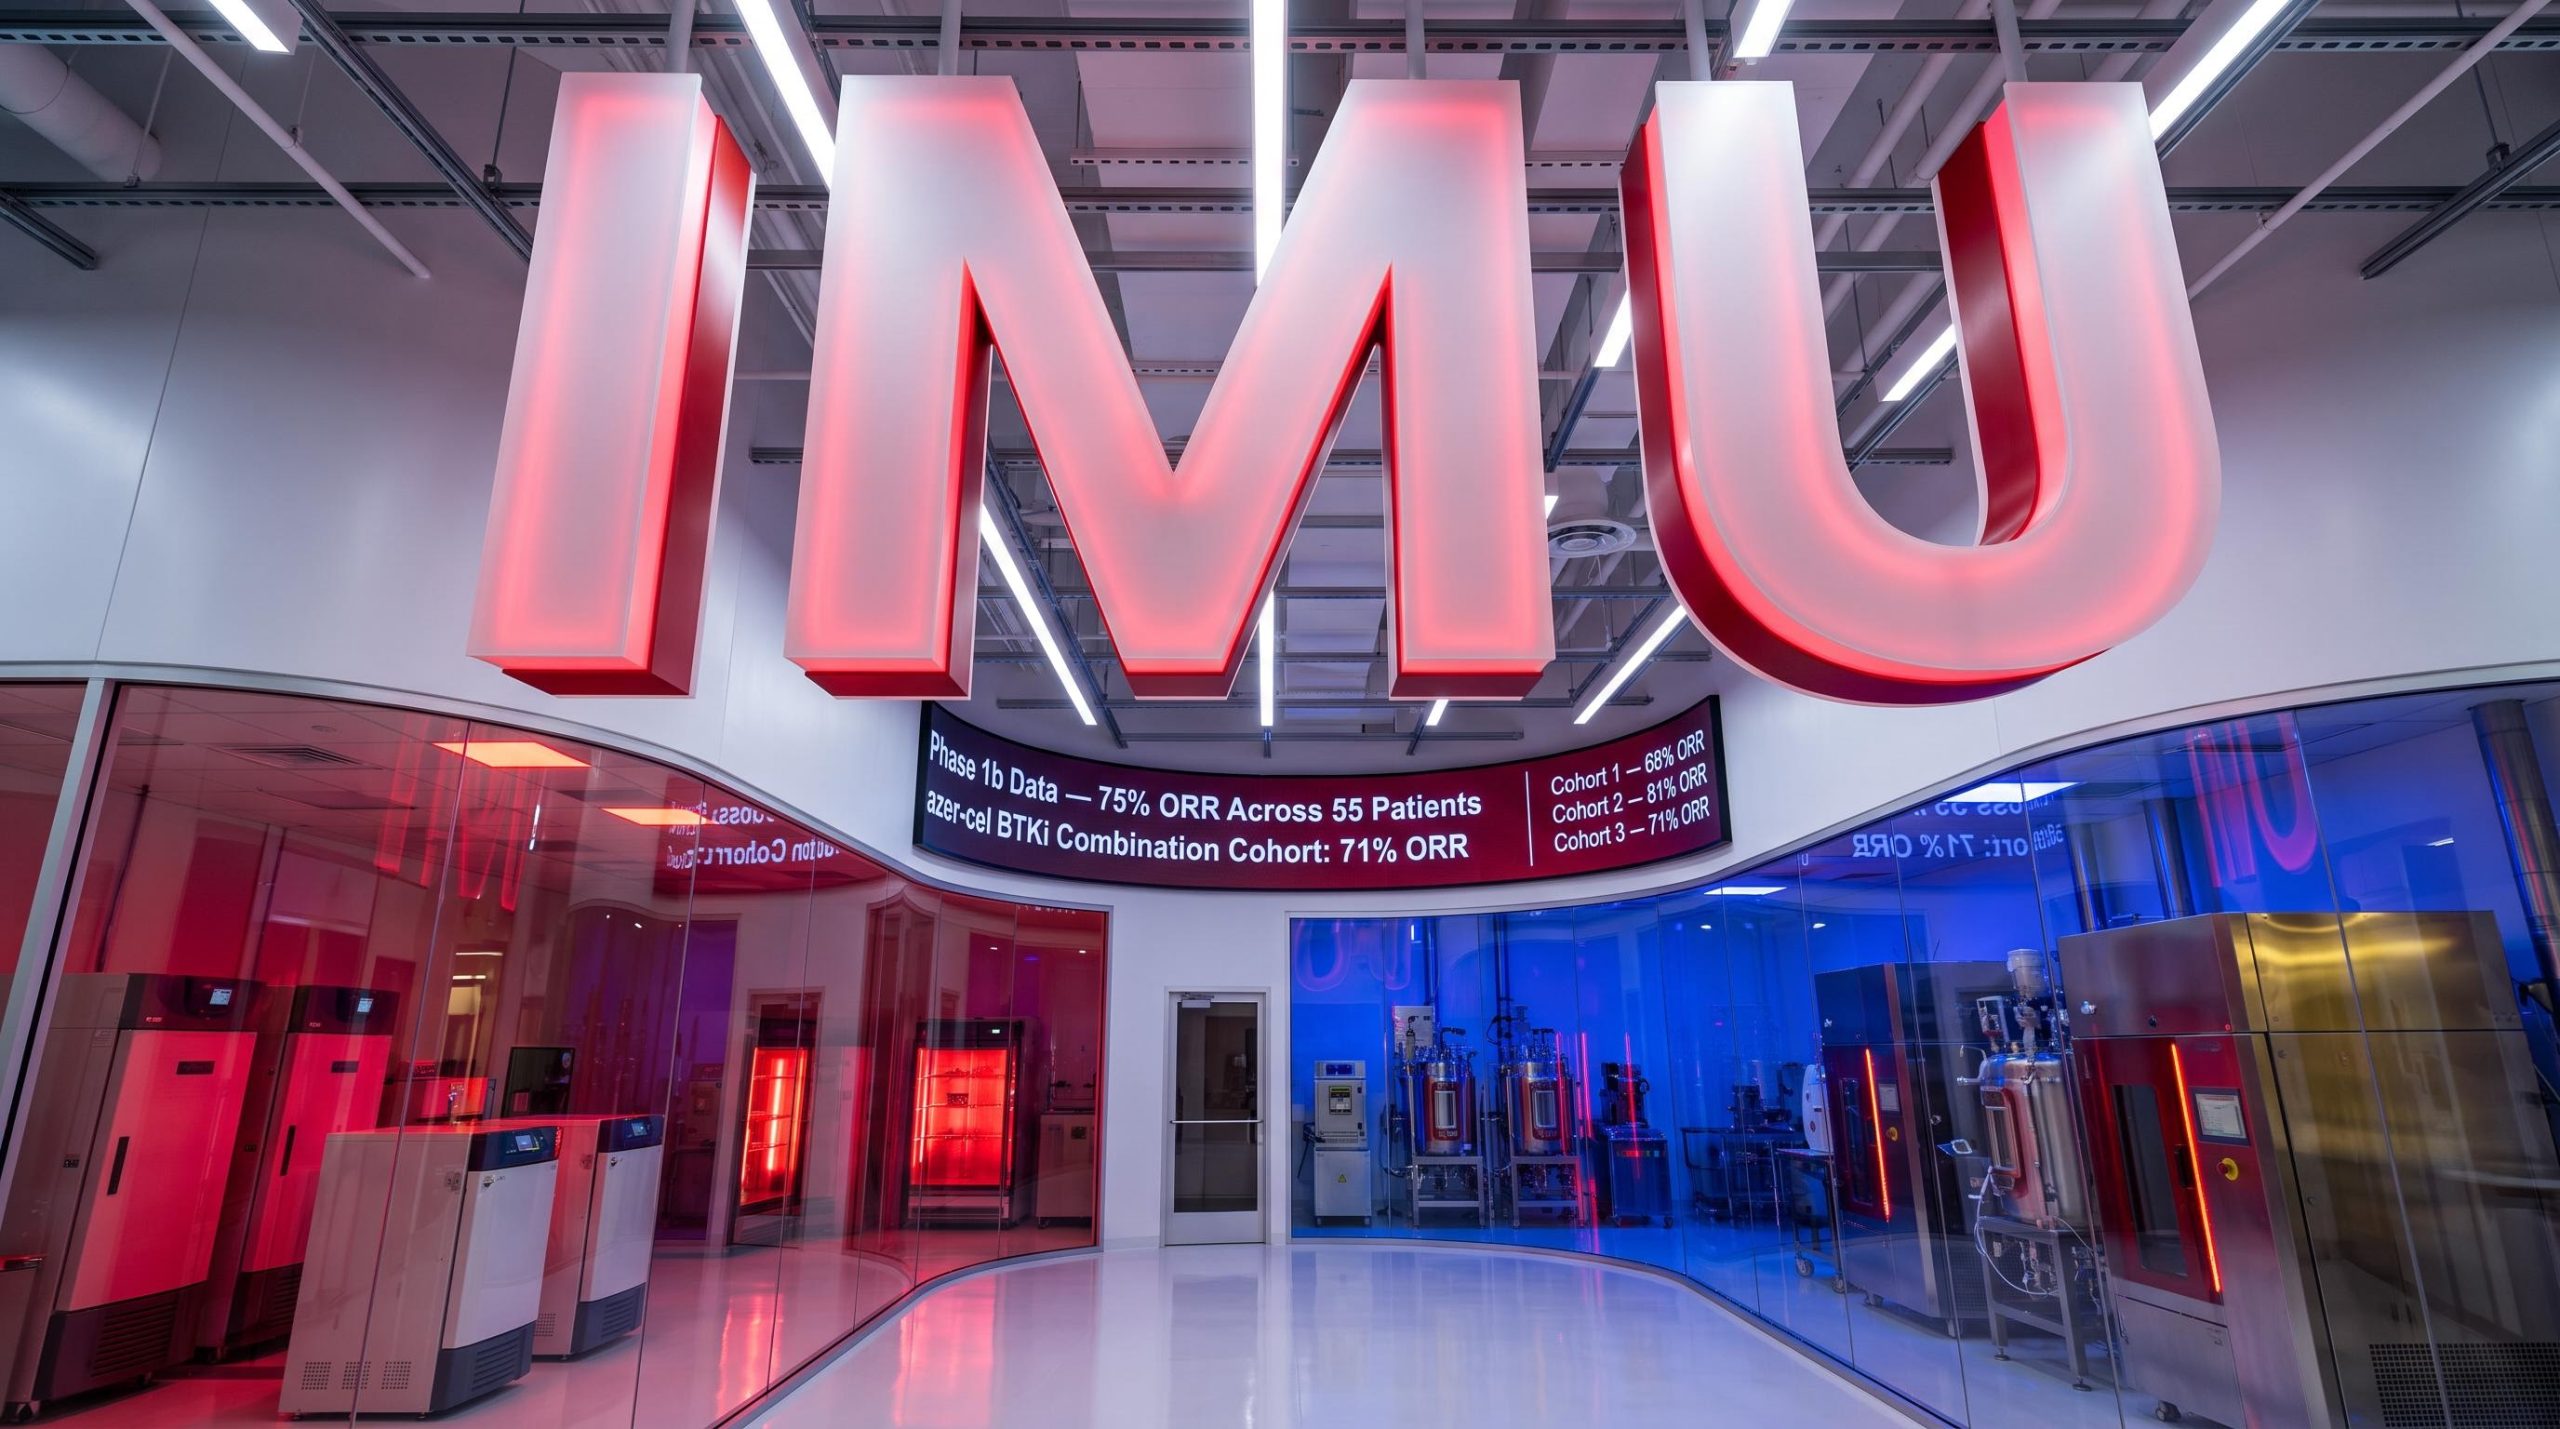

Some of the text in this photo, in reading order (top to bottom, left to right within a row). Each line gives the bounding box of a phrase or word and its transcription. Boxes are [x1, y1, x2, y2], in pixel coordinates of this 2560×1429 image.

[467, 72, 2222, 706] IMU
[929, 729, 976, 781] Phase
[981, 758, 1004, 791] 1b
[1009, 766, 1058, 804] Data
[1098, 785, 1151, 817] 75%
[1159, 792, 1221, 822] ORR
[1226, 796, 1324, 823] Across
[1332, 797, 1365, 823] 55
[1372, 791, 1483, 822] Patients
[1551, 767, 1608, 796] Cohort
[1612, 762, 1621, 783] 1
[1644, 745, 1676, 774] 68%
[1677, 729, 1706, 761] ORR
[1552, 797, 1610, 824] Cohort
[1613, 792, 1625, 814] 2
[1646, 776, 1678, 805] 81%
[1679, 762, 1709, 792] ORR
[926, 790, 1470, 864] azer-cel BTKi Combination Cohort: 71% ORR
[1554, 826, 1612, 853] Cohort
[1615, 822, 1627, 844] 3
[1648, 808, 1679, 836] 71%
[1681, 795, 1711, 826] ORR
